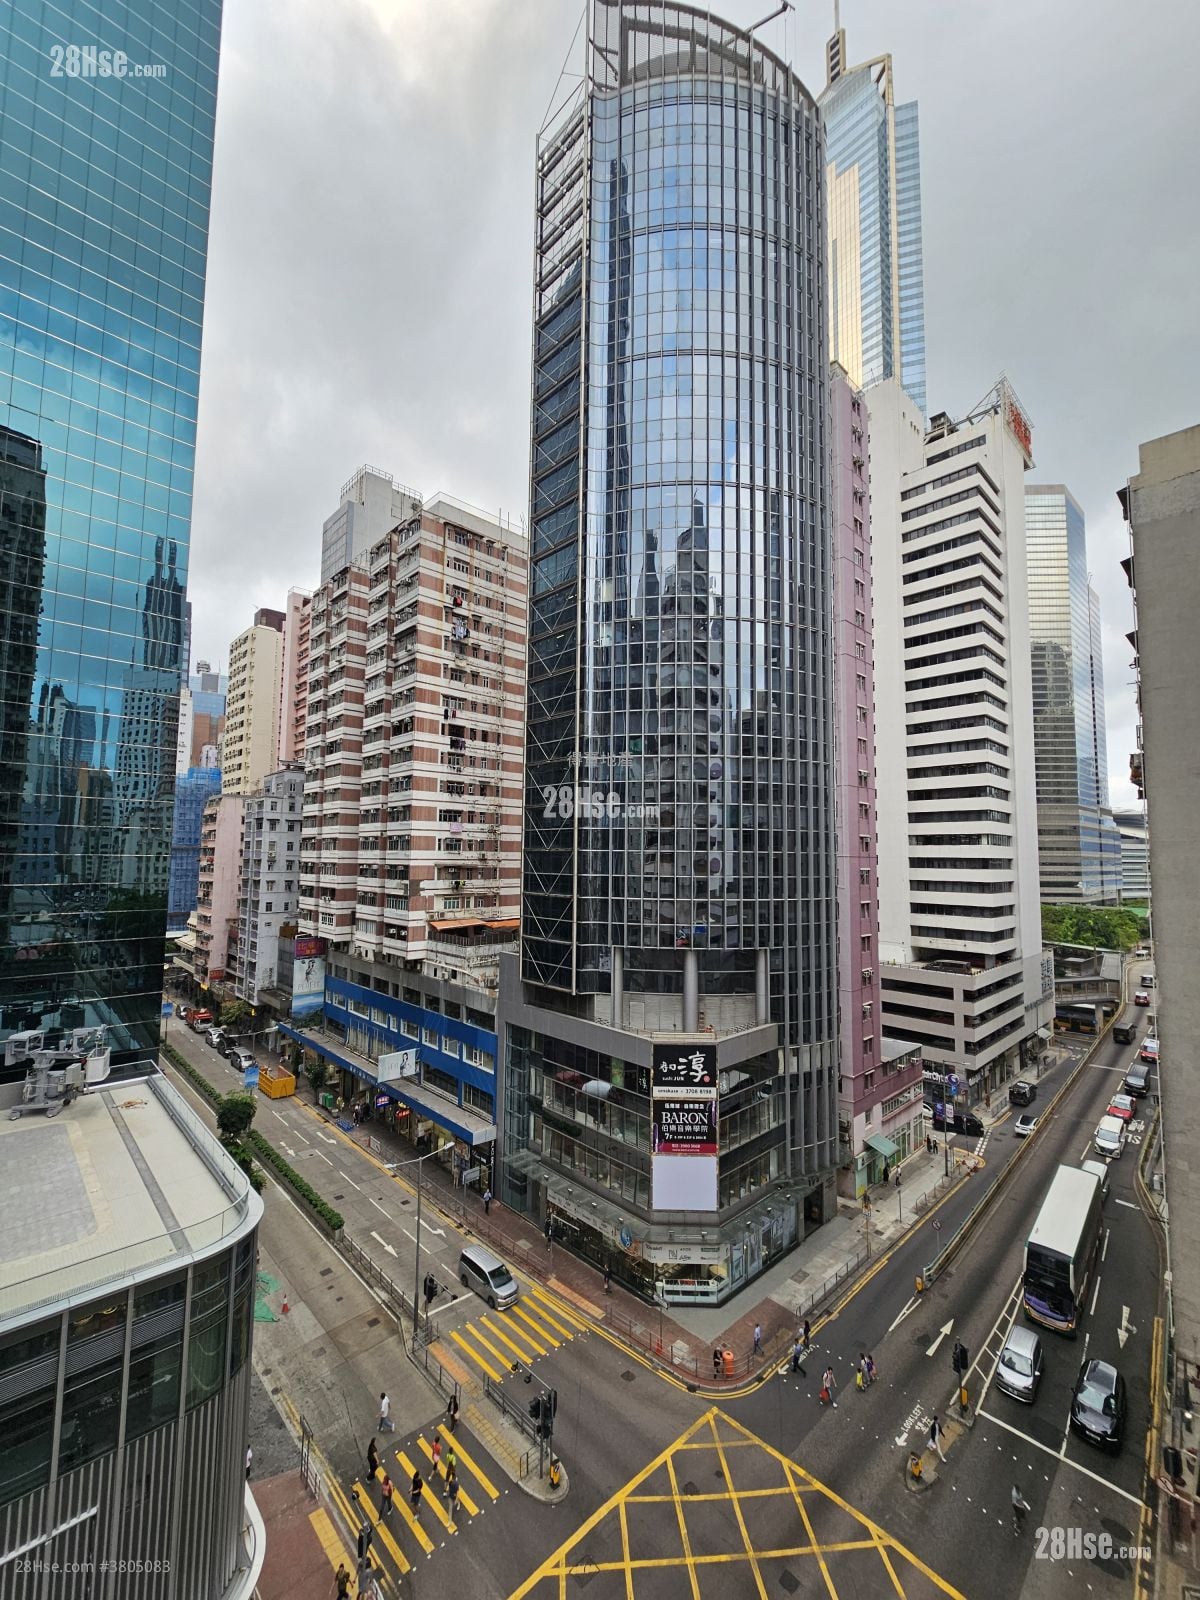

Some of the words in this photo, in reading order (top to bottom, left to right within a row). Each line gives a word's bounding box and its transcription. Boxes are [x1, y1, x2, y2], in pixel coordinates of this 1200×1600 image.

[661, 1112, 709, 1124] BARON
[900, 1416, 915, 1432] LOOK
[910, 1404, 925, 1420] LEFT
